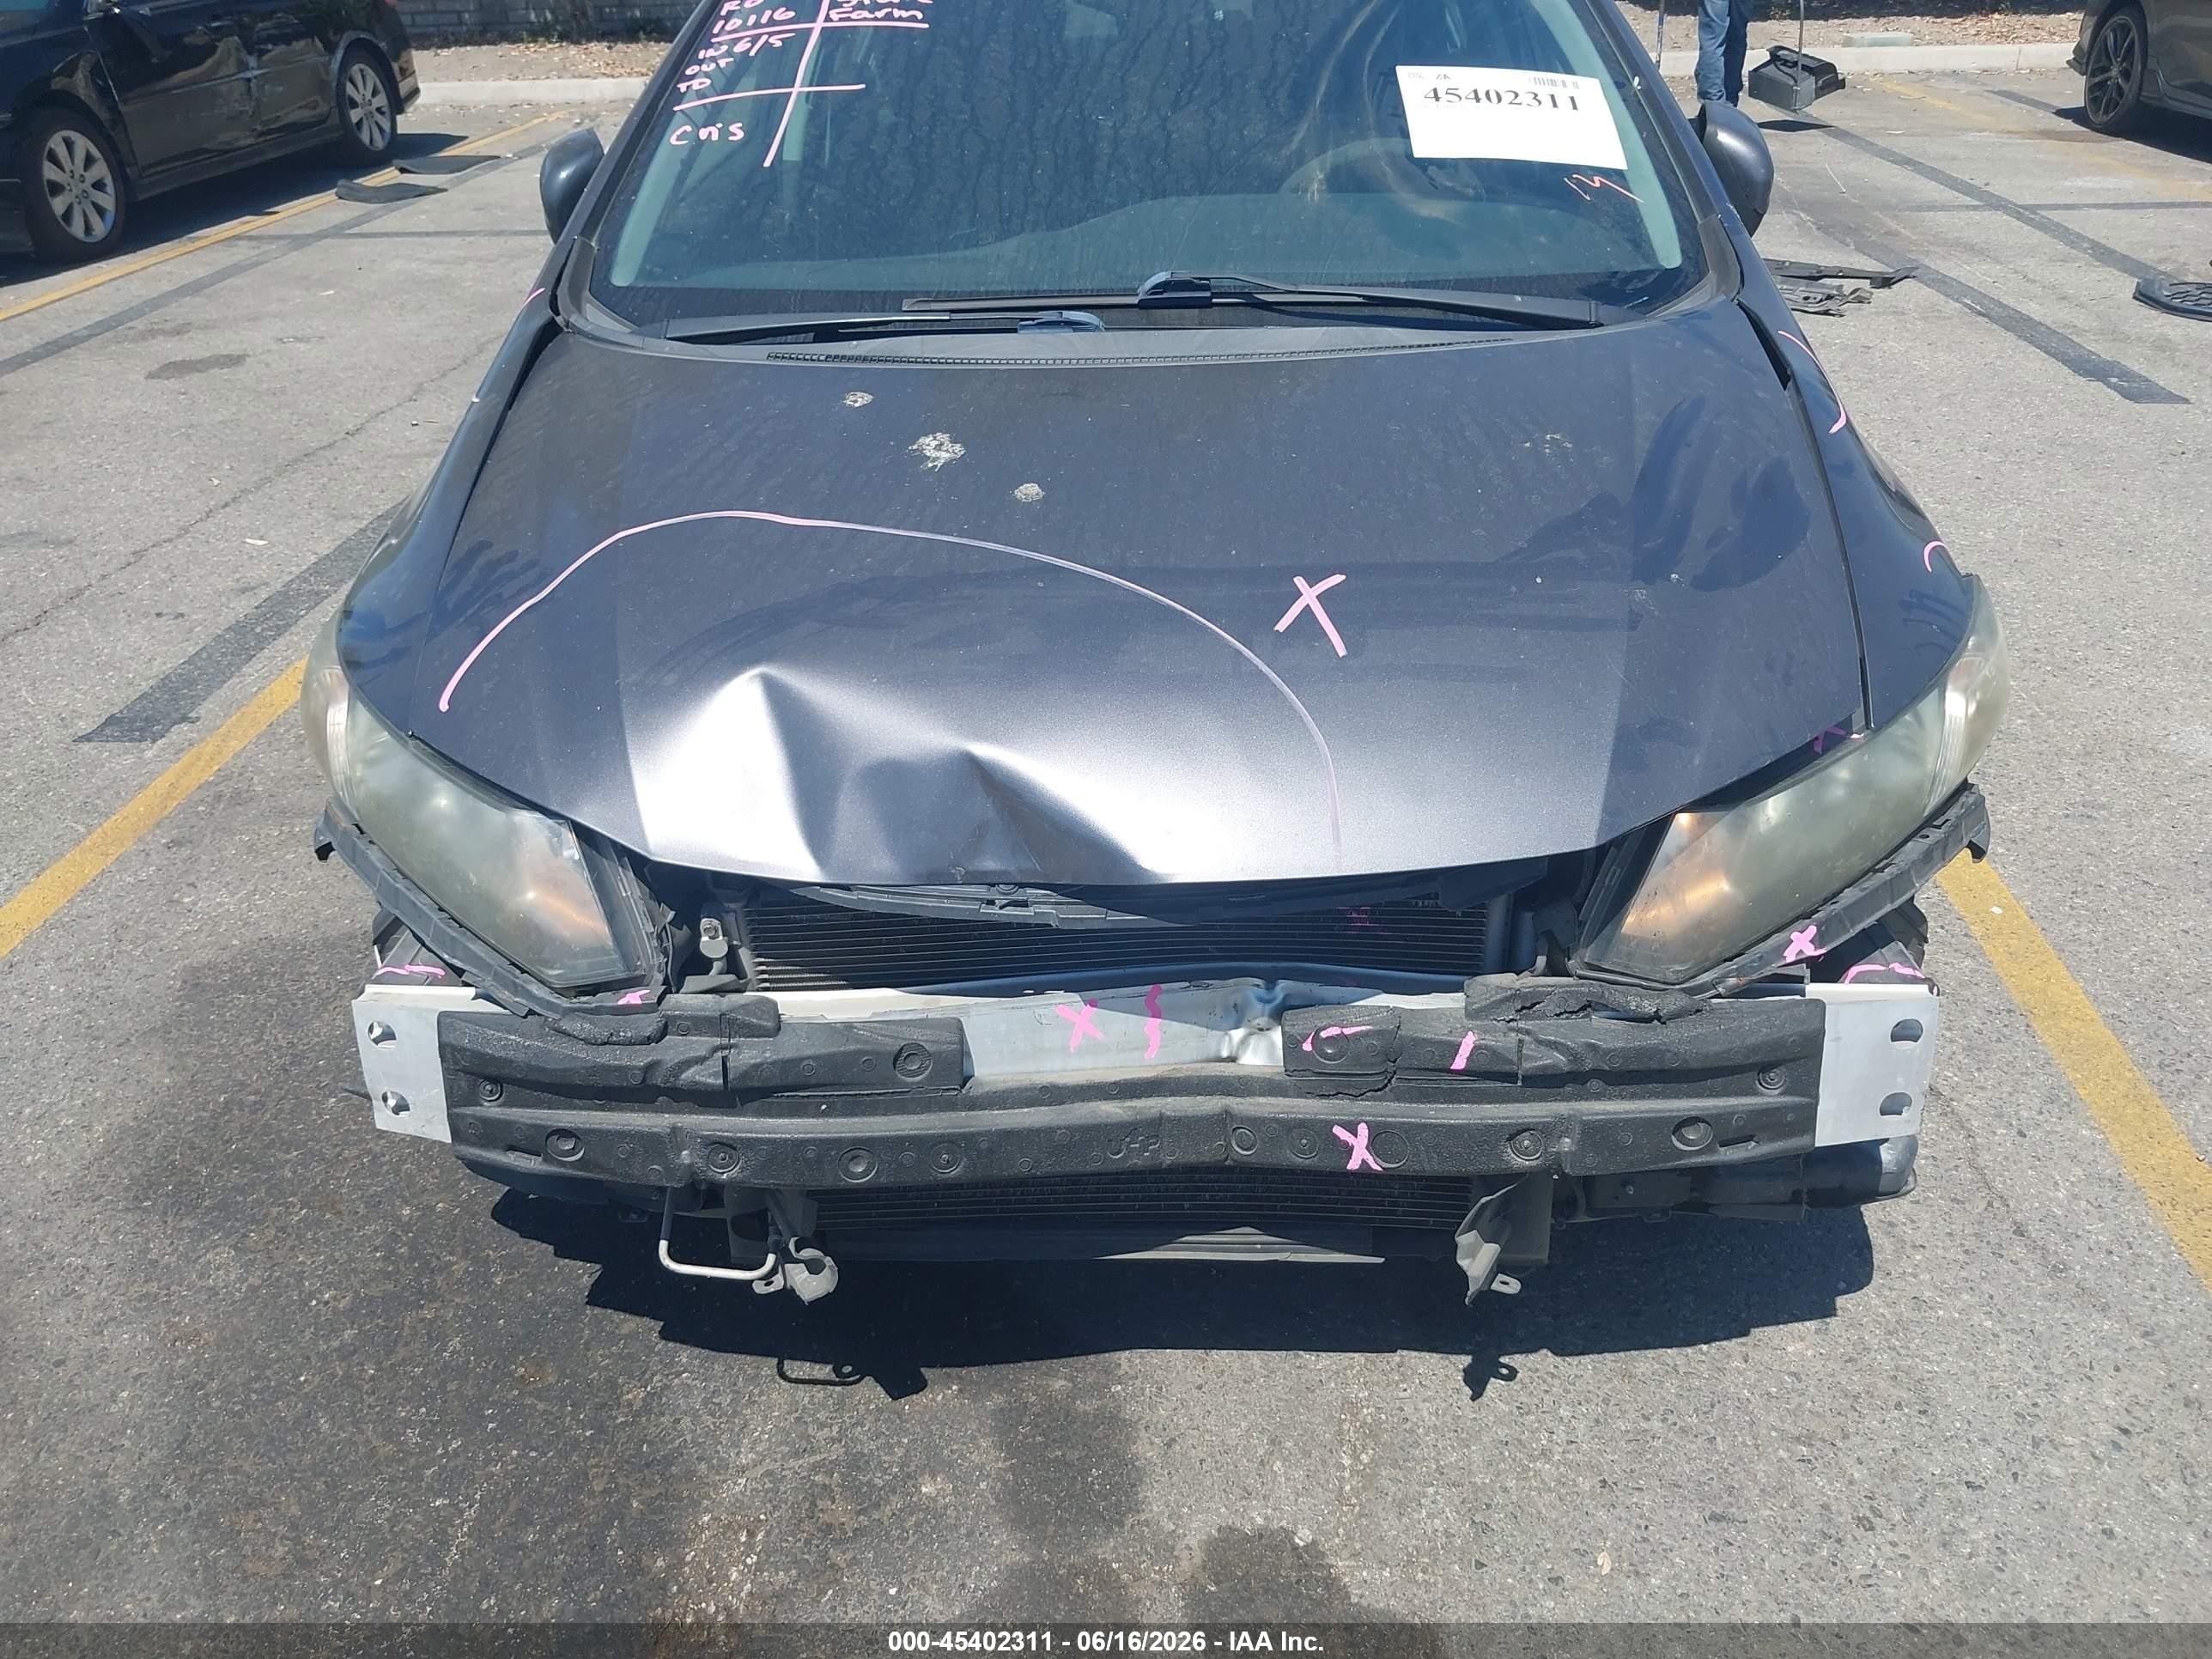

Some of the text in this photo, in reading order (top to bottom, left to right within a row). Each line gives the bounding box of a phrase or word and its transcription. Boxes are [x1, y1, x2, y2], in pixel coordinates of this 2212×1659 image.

[828, 7, 924, 21] Farm
[684, 57, 735, 76] OUT
[1424, 87, 1580, 112] 45402311
